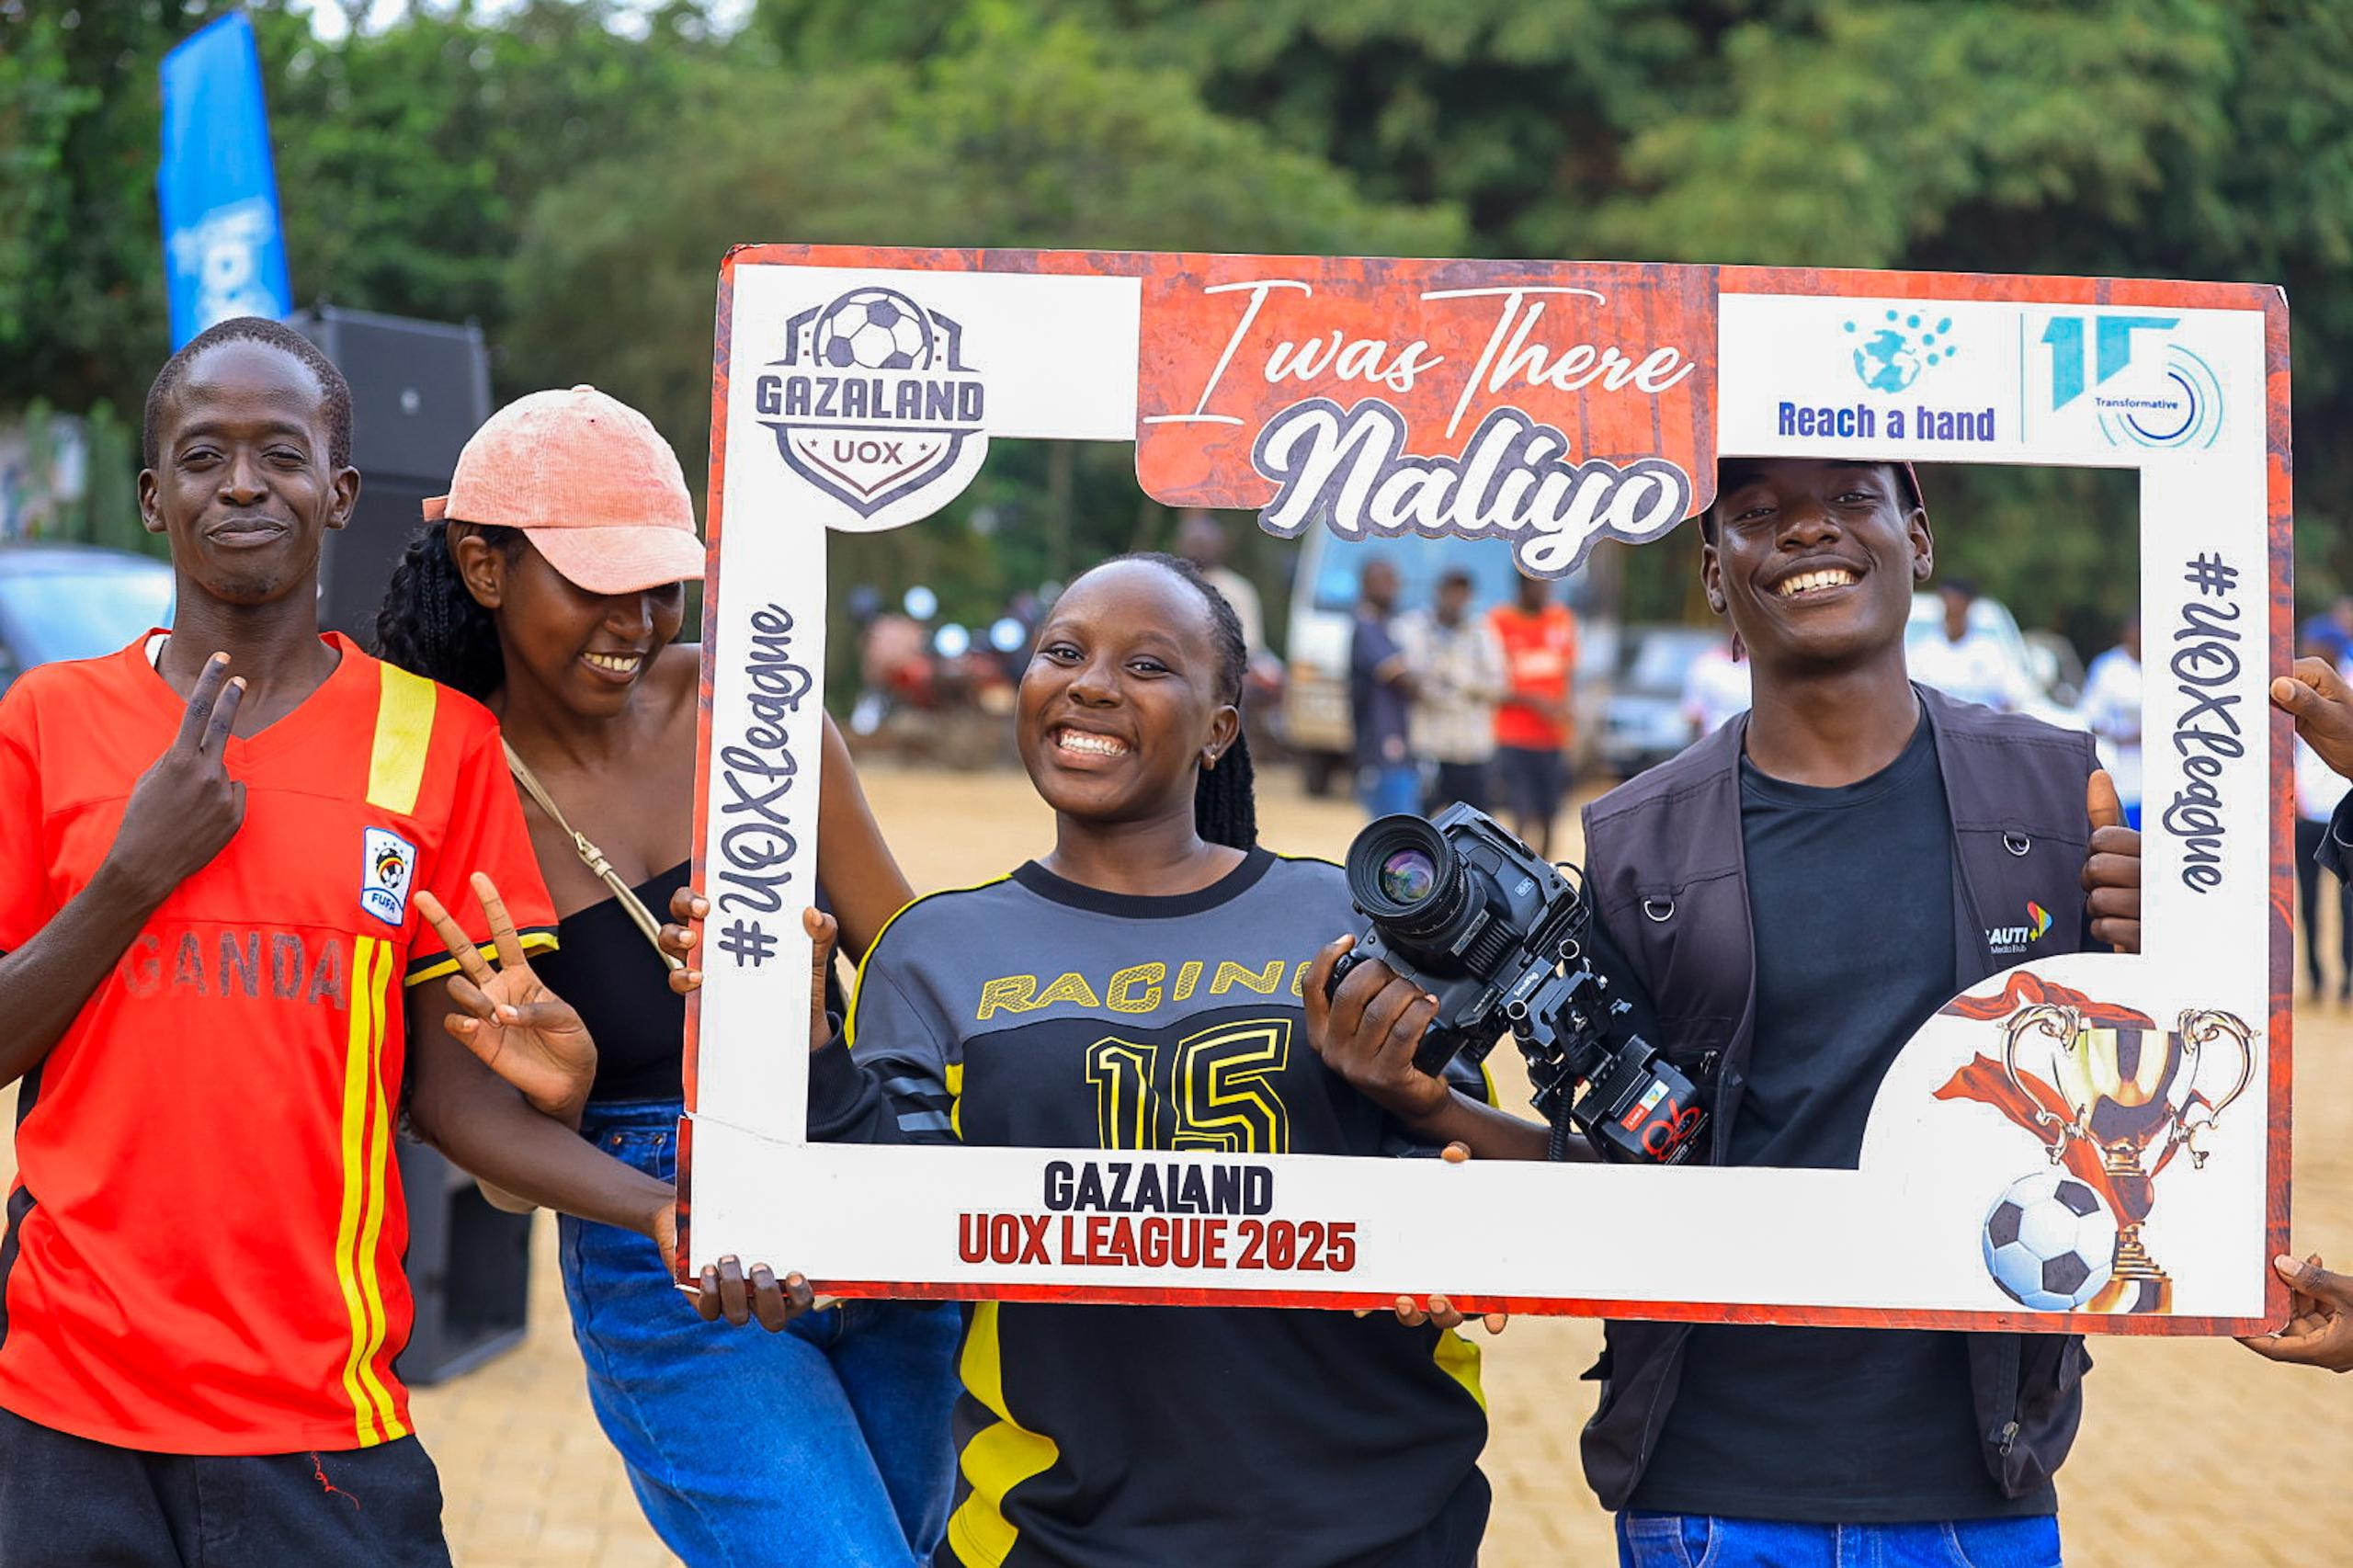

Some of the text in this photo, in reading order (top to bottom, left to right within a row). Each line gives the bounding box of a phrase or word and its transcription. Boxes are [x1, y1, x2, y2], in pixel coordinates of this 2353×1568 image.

[1264, 330, 1445, 392] was
[1420, 287, 1696, 438] There
[756, 375, 984, 422] GAZALAND
[1779, 402, 1995, 442] Reach a hand
[2096, 396, 2178, 410] Transformative
[833, 440, 904, 465] UOX
[1259, 404, 1684, 575] Naliyo
[372, 893, 395, 913] FUFA
[122, 931, 346, 1010] GANDA
[977, 961, 1313, 1020] RACIN
[1086, 1018, 1291, 1153] 15
[1044, 1162, 1273, 1215] GAZALAND
[959, 1213, 1357, 1272] UOX LEAGUE 2025
